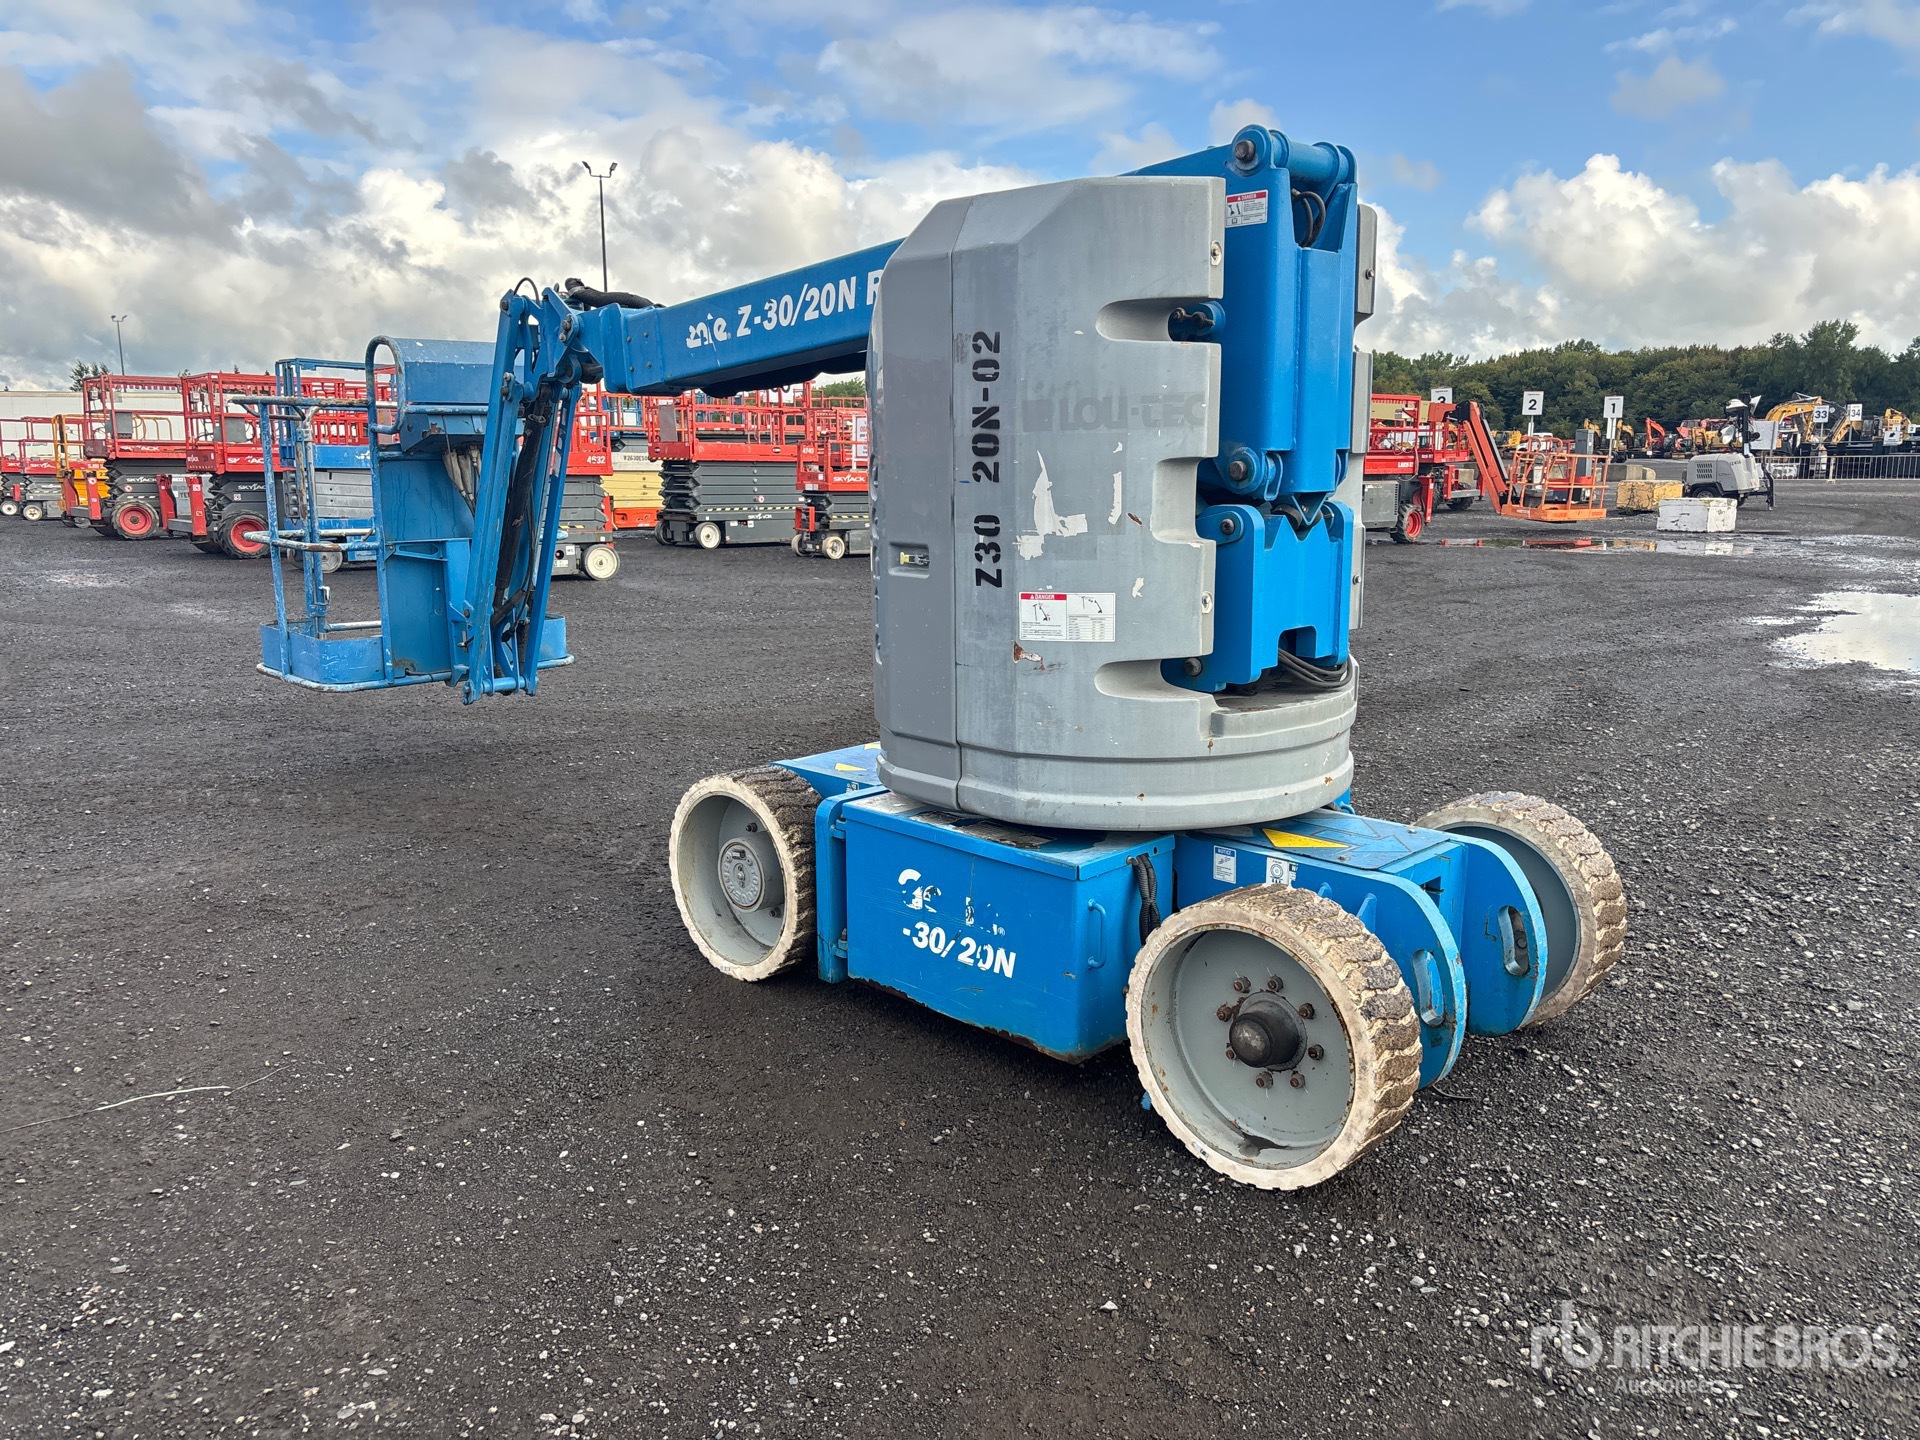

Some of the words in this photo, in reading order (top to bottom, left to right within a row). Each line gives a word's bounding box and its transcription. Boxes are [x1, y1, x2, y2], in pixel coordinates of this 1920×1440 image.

[736, 275, 857, 337] Z-30/20N
[971, 331, 1001, 484] 20N-02
[1527, 398, 1538, 411] 2
[1610, 402, 1617, 414] 1
[1814, 409, 1828, 420] 33
[1850, 408, 1861, 418] 34
[833, 474, 866, 483] SKYJACK
[973, 514, 1003, 589] Z30
